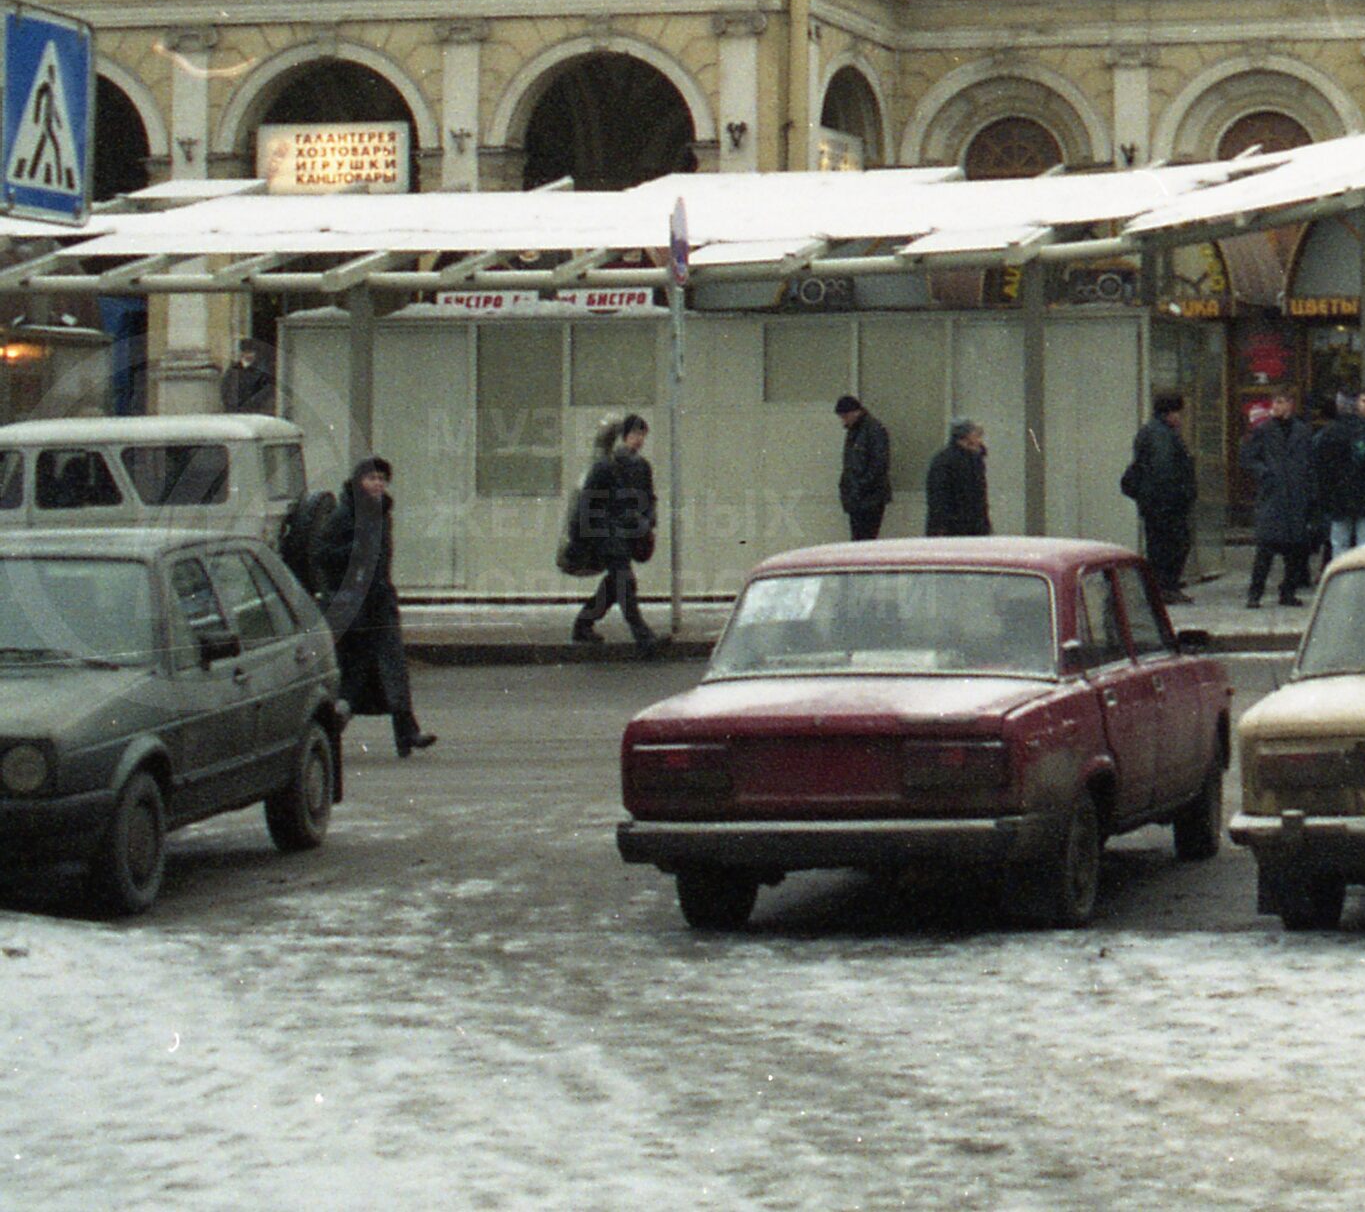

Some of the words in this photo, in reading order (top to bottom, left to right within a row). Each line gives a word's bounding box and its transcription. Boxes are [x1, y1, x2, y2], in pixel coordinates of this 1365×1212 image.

[295, 132, 397, 144] ГАЛАНТЕРЕЯ
[295, 146, 397, 158] ХОЗТОВАРЫ
[295, 159, 397, 171] ИГРУШКИ
[295, 173, 397, 185] КАНЦТОВАРЫ
[586, 291, 647, 307] БИСТРО
[1291, 297, 1361, 316] ЦВЕТЫ
